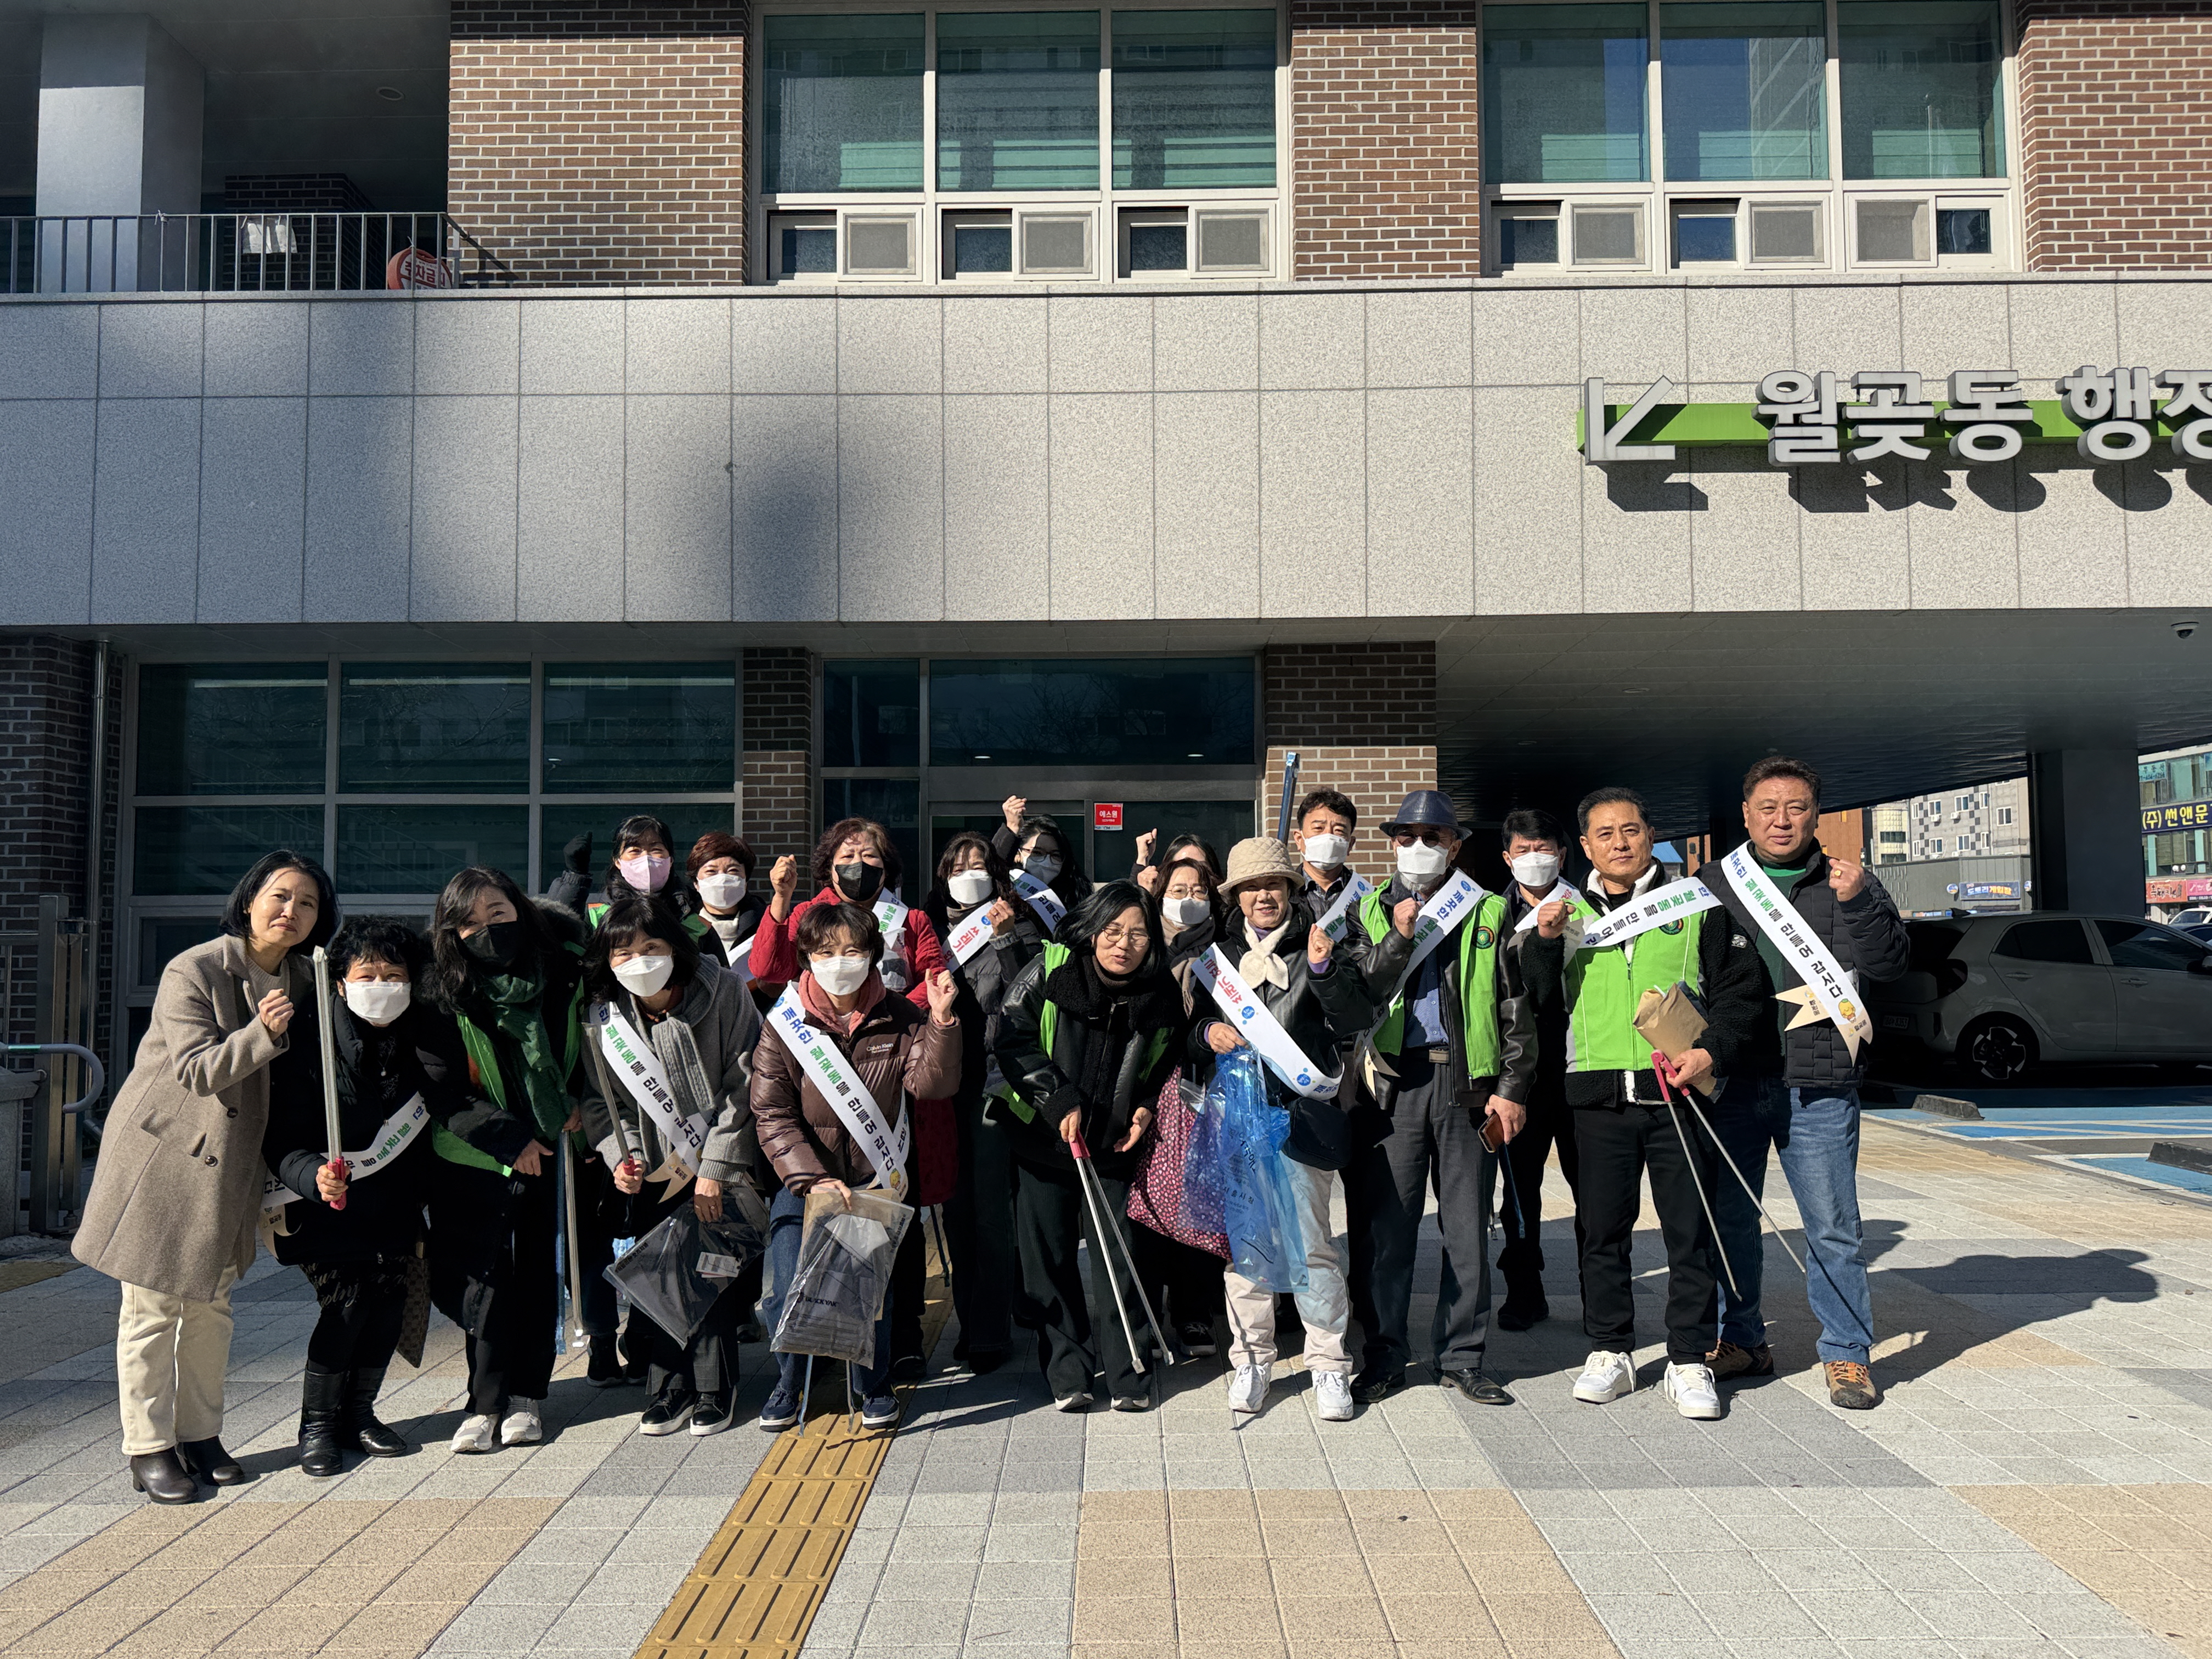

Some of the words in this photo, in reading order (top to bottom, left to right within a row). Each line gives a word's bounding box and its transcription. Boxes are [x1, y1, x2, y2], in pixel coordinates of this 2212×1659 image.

[1753, 370, 2034, 466] 월곶동
[2142, 810, 2162, 830] (주)
[2165, 804, 2208, 827] 썬앤문
[1437, 890, 1465, 920] 깨끗한
[1644, 889, 1696, 917] 월곶동을
[952, 926, 980, 953] 쓰레기
[1745, 878, 1784, 922] 월곶동을
[1780, 922, 1814, 958] 만들어
[1811, 960, 1843, 998] 갑시다
[1217, 976, 1243, 1005] 쓰레기
[605, 1024, 646, 1076] 월곶동을
[643, 1076, 674, 1114] 만들어
[781, 1006, 814, 1045] 깨끗한
[809, 1046, 851, 1096] 월곶동을
[847, 1097, 878, 1135] 만들어
[874, 1135, 894, 1171] 갑시다
